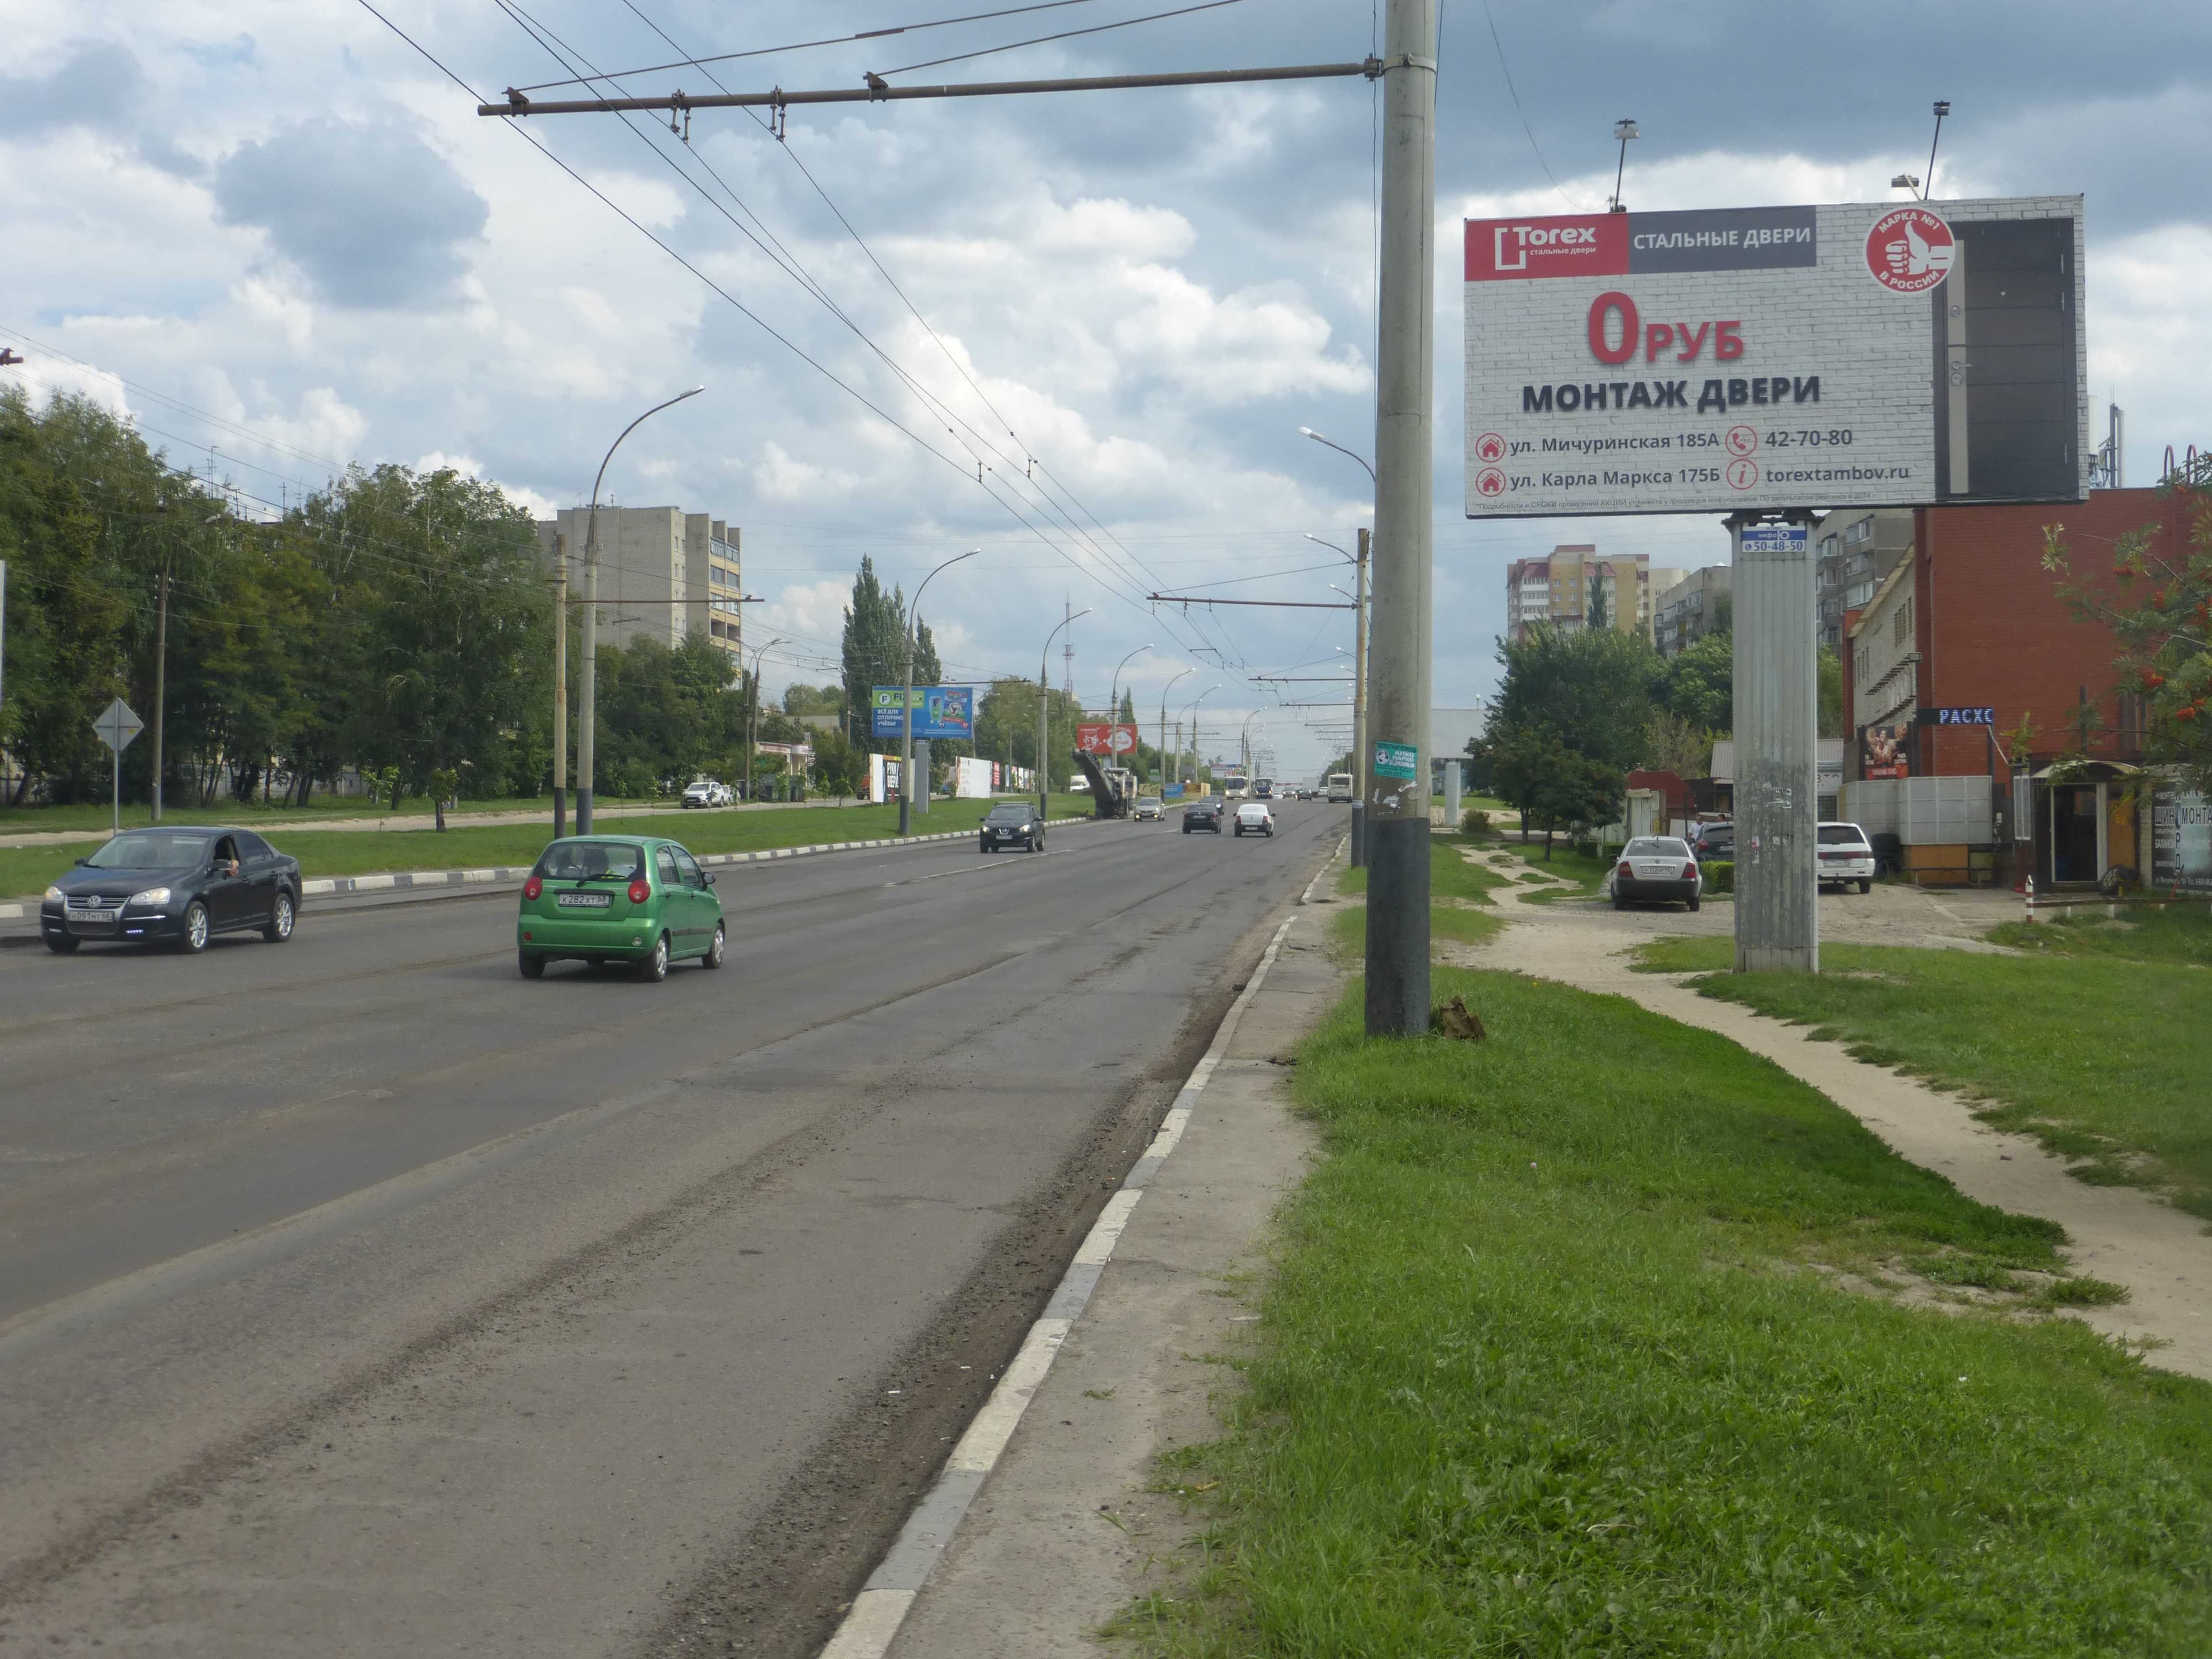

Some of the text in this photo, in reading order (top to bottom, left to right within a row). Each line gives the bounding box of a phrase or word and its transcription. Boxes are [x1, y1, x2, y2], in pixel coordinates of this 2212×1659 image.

[1878, 211, 1941, 233] МАРКА №1
[1512, 226, 1596, 245] Torex
[1634, 228, 1810, 249] СТАЛЬНЫЕ ДВЕРИ
[1530, 247, 1596, 256] стальные двери
[1879, 271, 1940, 289] В РОССИИ
[1646, 320, 1744, 363] РУБ
[1522, 376, 1820, 414] МОНТАЖ ДВЕРИ
[1510, 433, 1719, 457] ул. Мичуринская 185А
[1765, 430, 1853, 447] 42-70-80
[1510, 468, 1720, 491] ул. Карла Маркса 175Б
[1766, 466, 1909, 483] torextambov.ru
[1600, 499, 1627, 507] АКЦИИ
[1754, 541, 1803, 551] 50-48-50
